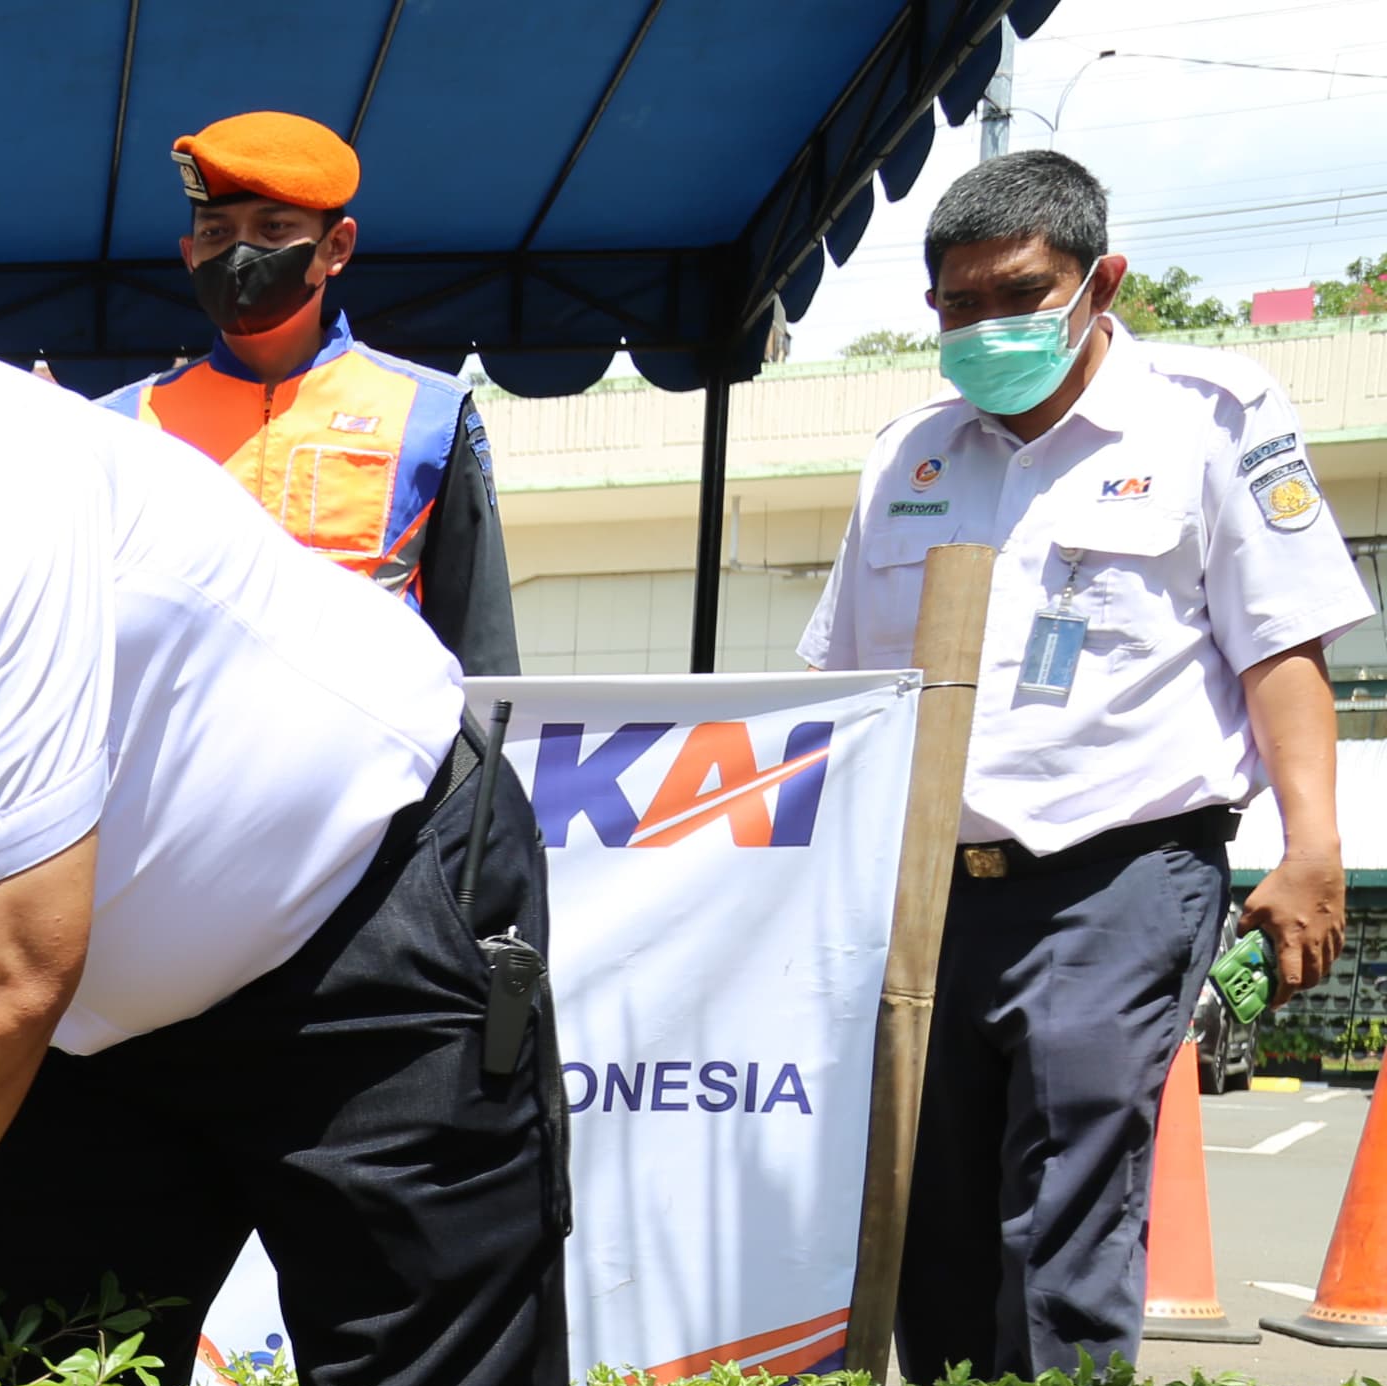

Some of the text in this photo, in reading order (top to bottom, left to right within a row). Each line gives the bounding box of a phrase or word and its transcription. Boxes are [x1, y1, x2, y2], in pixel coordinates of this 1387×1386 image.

[1101, 477, 1152, 497] KAI
[531, 721, 835, 848] KAI
[560, 1061, 813, 1115] ONESIA
